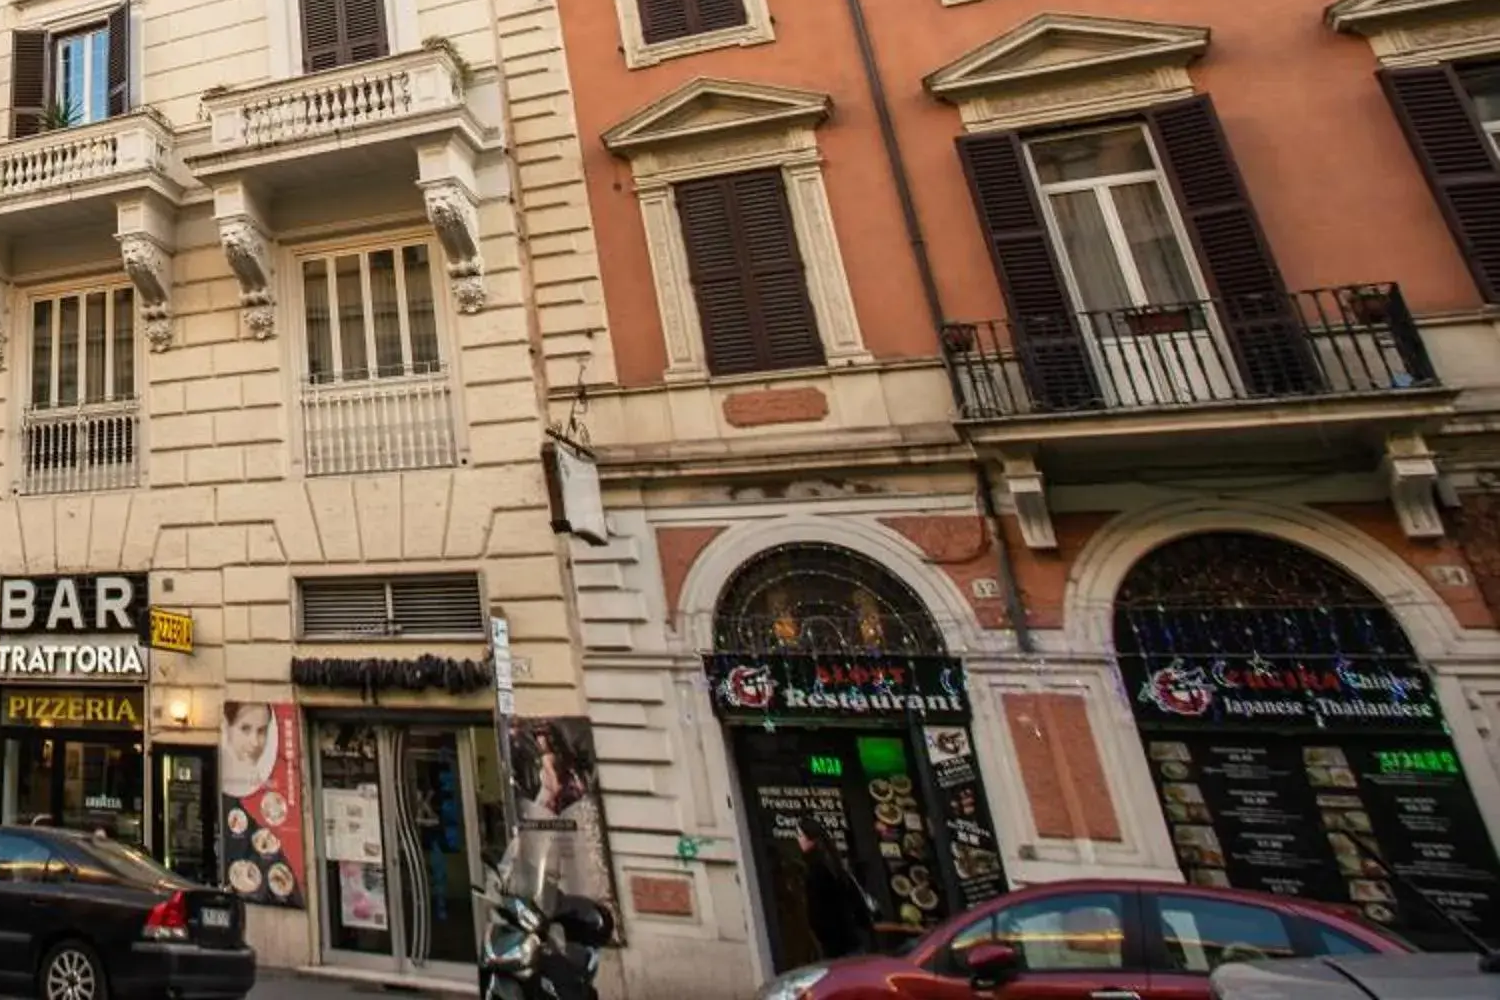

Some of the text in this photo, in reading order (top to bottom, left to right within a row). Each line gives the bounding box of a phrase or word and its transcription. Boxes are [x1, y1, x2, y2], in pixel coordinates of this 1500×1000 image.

[1, 577, 134, 629] BAR
[8, 696, 137, 721] PIZZERIA
[784, 689, 962, 712] Restaurant
[1320, 698, 1433, 717] Thailandese
